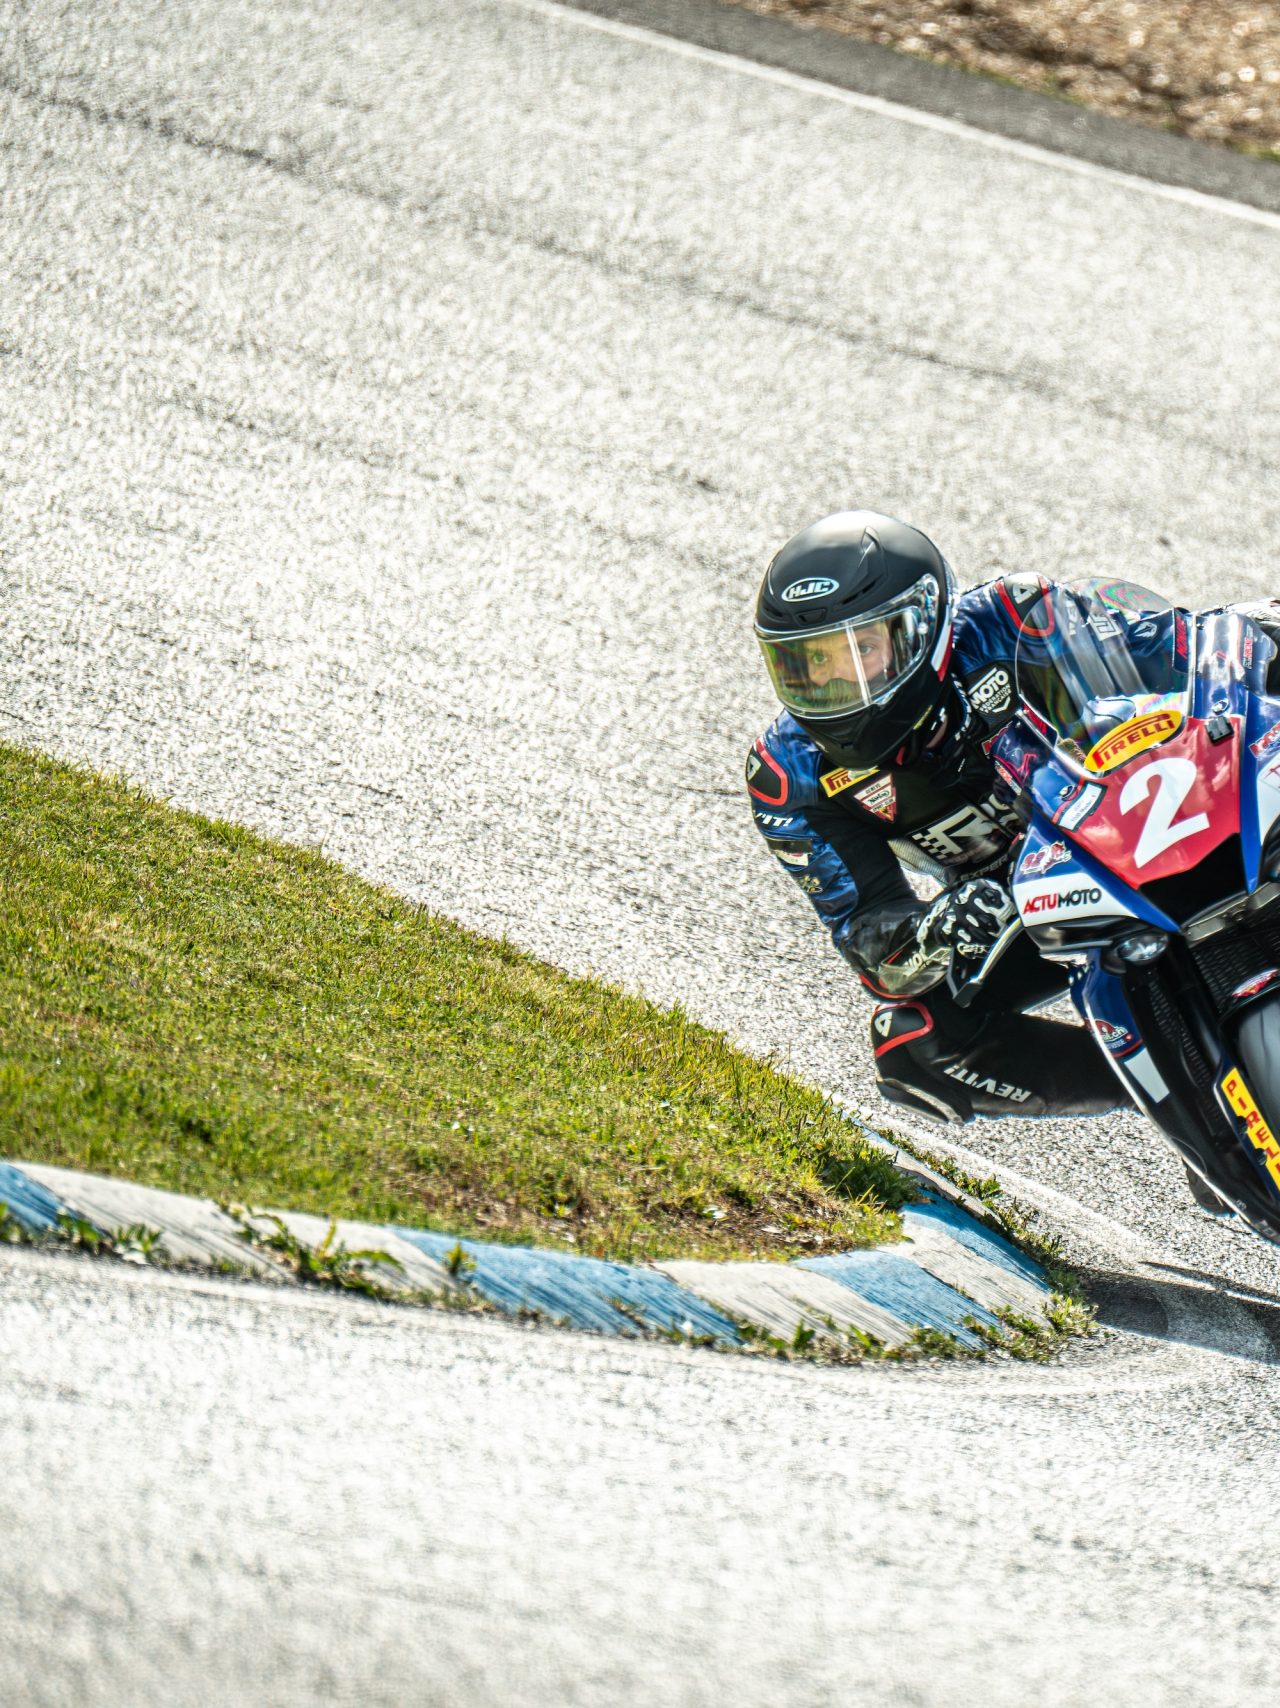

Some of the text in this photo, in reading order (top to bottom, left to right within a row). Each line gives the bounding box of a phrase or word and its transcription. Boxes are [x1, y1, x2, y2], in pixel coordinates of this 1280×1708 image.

[788, 579, 832, 602] HJC
[970, 670, 1009, 710] MOTO
[1092, 713, 1175, 769] PIRELLI
[1119, 757, 1210, 869] 2
[943, 1064, 1033, 1104] REV'IT!
